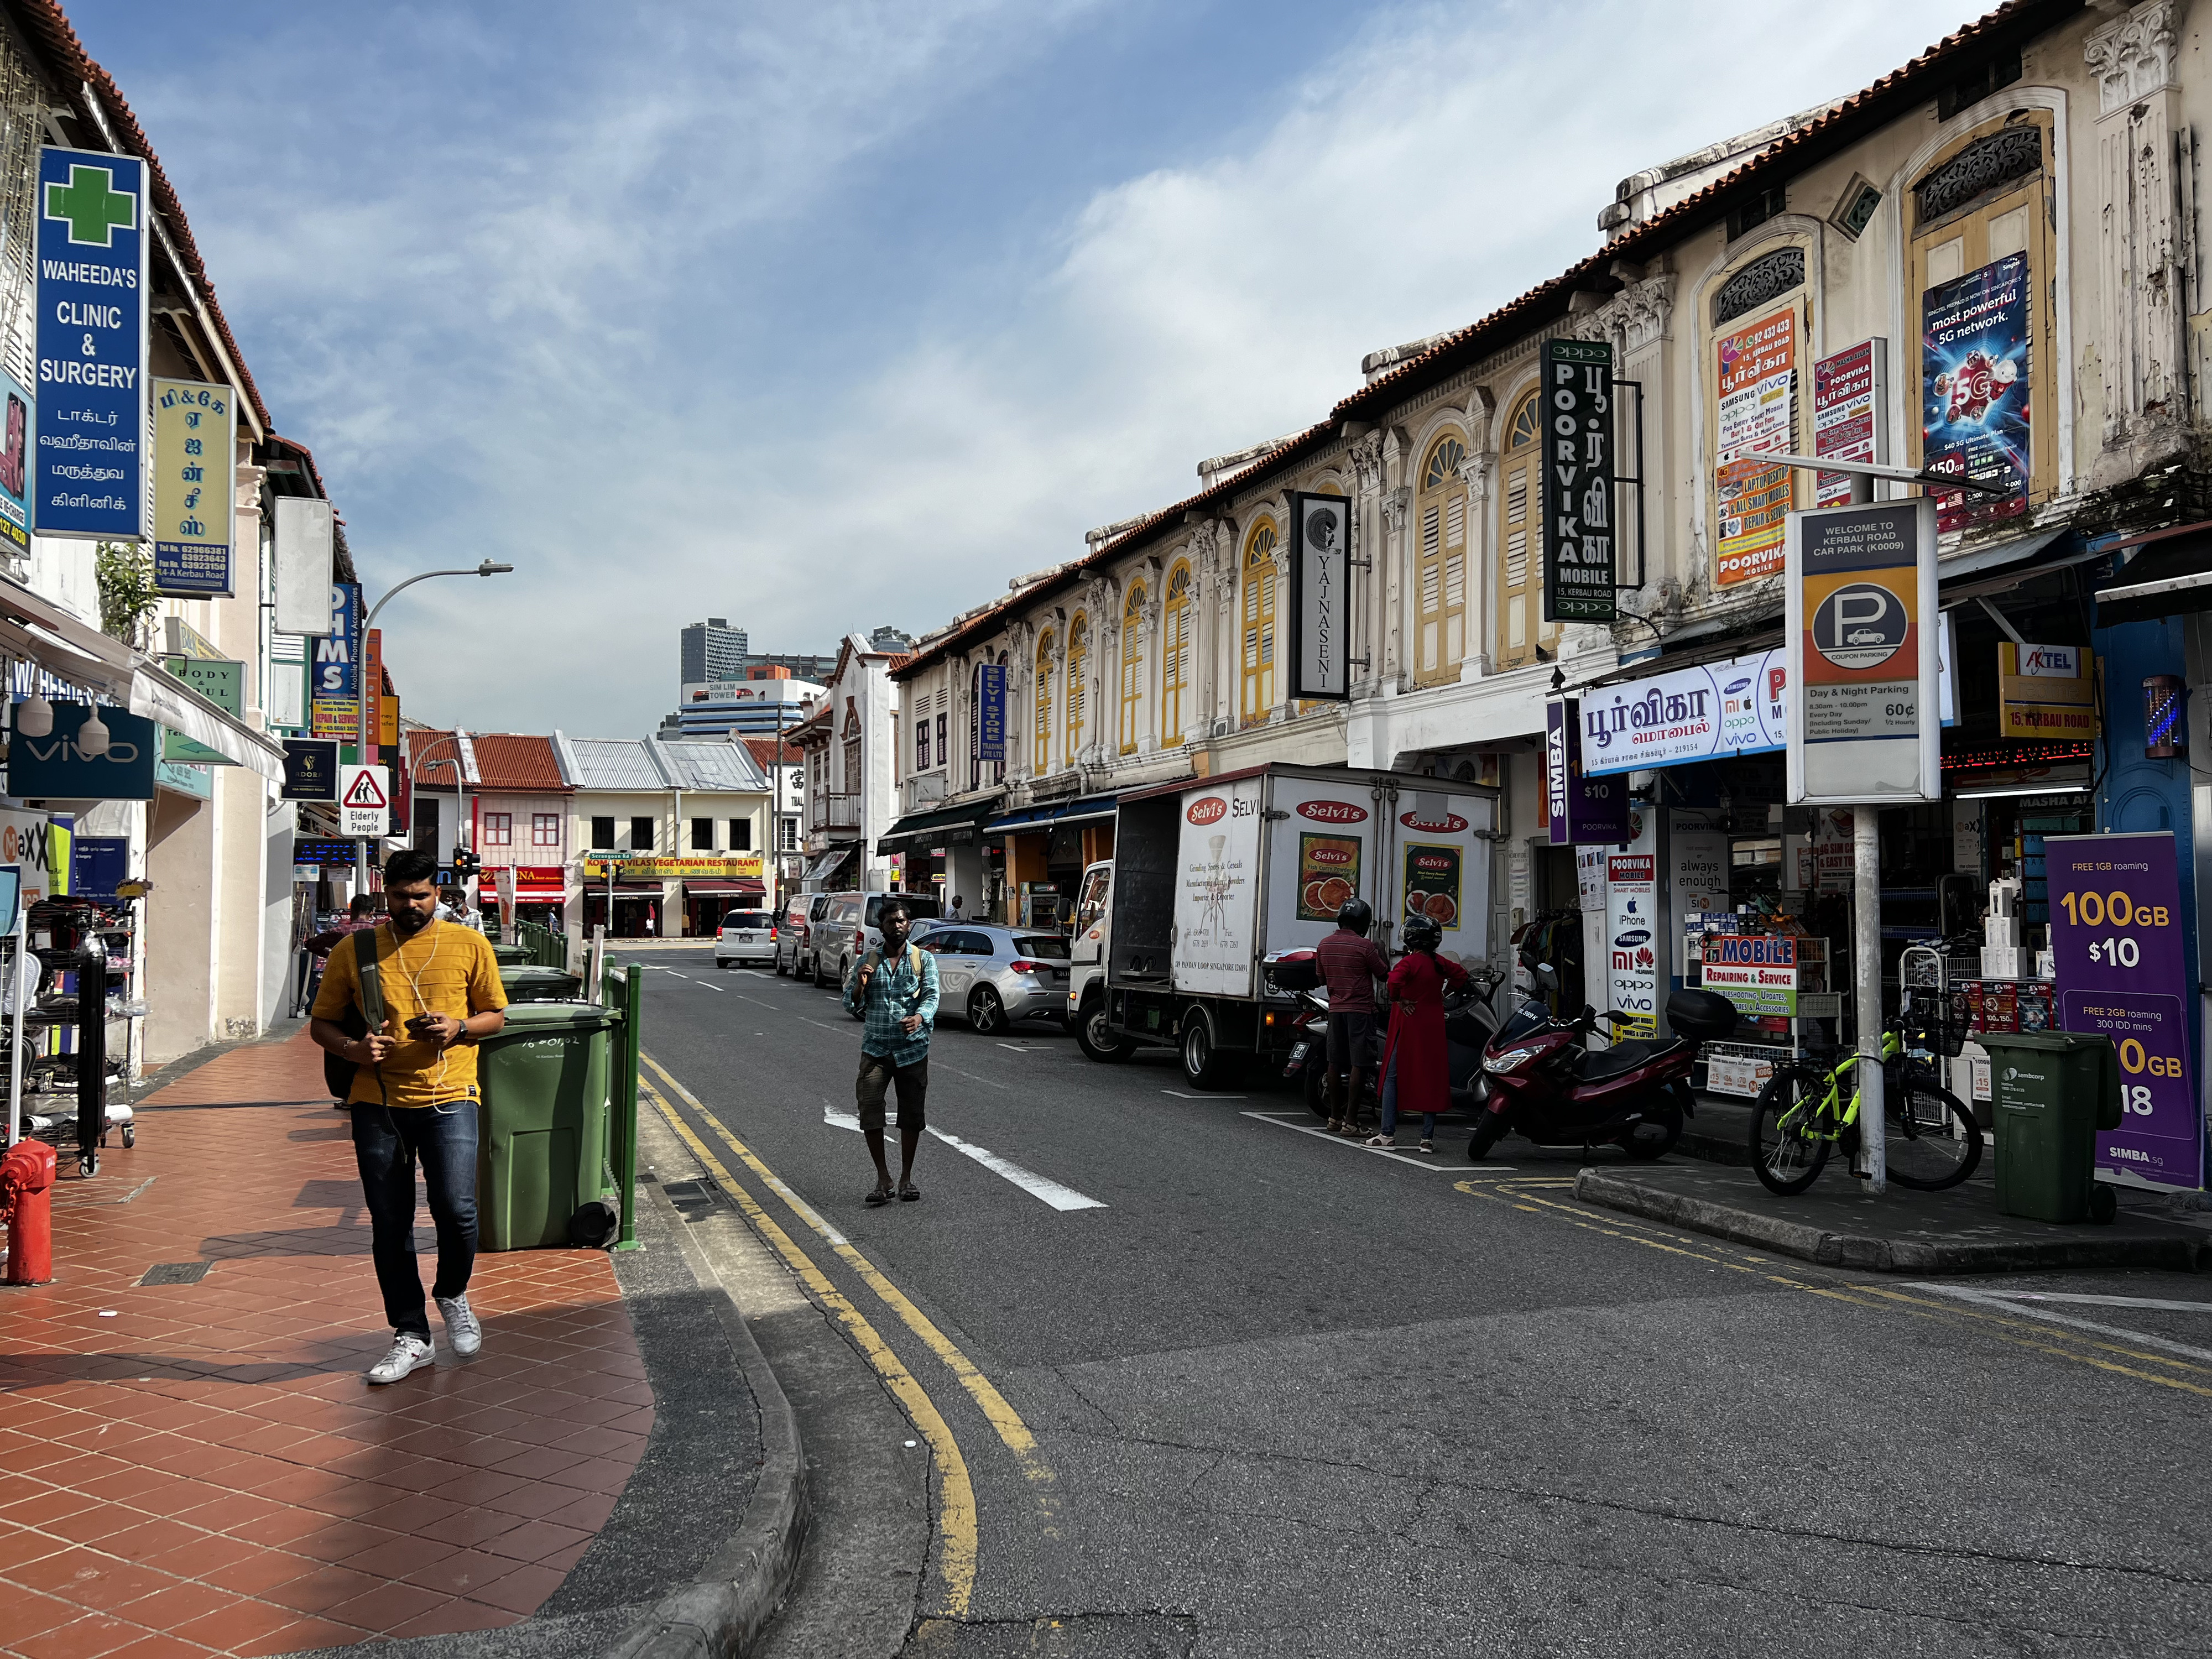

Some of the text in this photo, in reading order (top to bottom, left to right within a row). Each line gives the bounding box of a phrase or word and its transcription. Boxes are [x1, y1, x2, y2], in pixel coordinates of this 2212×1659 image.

[2003, 260, 2020, 270] Singtel
[42, 259, 137, 289] WAHEEDA'S
[56, 301, 121, 328] CLINIC
[1933, 289, 2016, 331] most powerful
[1755, 319, 1790, 345] 92 433 433
[1939, 311, 2008, 345] 5G network.
[81, 333, 96, 356] &
[1553, 346, 1607, 359] oppo
[1837, 347, 1869, 367] MASHA ALLAH
[40, 359, 136, 389] SURGERY
[1722, 351, 1787, 393] பூர்விகா
[1830, 364, 1870, 386] POORVIKA
[1757, 375, 1788, 395] vivo
[1721, 390, 1755, 410] SAMSUNG
[1846, 395, 1870, 408] vivo
[58, 409, 118, 427] டாக்டர்
[1720, 404, 1755, 421] oppo
[1817, 405, 1845, 421] SAMSUNG
[1818, 415, 1845, 429] oppo
[39, 434, 136, 452] வஹீதாவின்
[1965, 434, 1989, 444] Ultimate
[52, 463, 124, 481] மருத்துவ
[1554, 364, 1579, 564] POORVIKA
[51, 492, 126, 510] கிளினிக்
[1736, 499, 1746, 514] ALL
[1748, 493, 1768, 510] SMART
[1768, 483, 1790, 503] MOBILES
[1819, 491, 1833, 499] Singtel
[1825, 523, 1876, 535] WELCOME
[1823, 532, 1896, 545] KERBAU ROAD
[182, 546, 226, 555] 62966381
[1814, 541, 1903, 556] CAR PARK (K0009)
[181, 561, 226, 570] 63923150
[182, 554, 226, 562] 63923643
[177, 570, 204, 578] Kerbau
[206, 571, 225, 579] Road
[1560, 568, 1608, 585] MOBILE
[1557, 588, 1611, 598] 15, KERBAU ROAD
[1558, 601, 1611, 614] oppo
[1318, 555, 1331, 688] YAJNASENI
[1834, 592, 1887, 646] P
[179, 670, 229, 679] BODY
[986, 667, 1000, 702] SELVI
[1727, 682, 1748, 691] SAMSUNG
[1810, 690, 1829, 698] Day
[1841, 687, 1867, 696] Night
[1870, 686, 1909, 694] Parking
[1587, 688, 1709, 748] பூர்விகா
[1885, 703, 1914, 718] 60¢
[985, 706, 1000, 740] STORE
[1725, 717, 1755, 729] oppo
[2010, 712, 2089, 728] 15, KERBAU ROAD
[1632, 718, 1709, 744] மொபைல்
[1725, 733, 1756, 745] vivo
[1550, 726, 1564, 817] SIMBA
[1585, 785, 1609, 799] $10
[1191, 798, 1259, 821] Selvi's SELVI
[2019, 796, 2068, 807] MASHA
[351, 811, 379, 822] Elderly
[1306, 804, 1360, 820] Selvi's
[352, 823, 378, 833] People
[1314, 851, 1347, 860] Selvi's
[1830, 843, 1843, 853] SIM
[1418, 859, 1448, 867] Selvi's
[1611, 858, 1651, 870] POORVIKA
[1681, 860, 1719, 874] always
[2072, 863, 2094, 871] FREE
[2114, 862, 2148, 872] roaming
[1679, 875, 1720, 889] enough
[2060, 891, 2169, 926] 100GB
[1619, 915, 1645, 925] iPhone
[1722, 940, 1792, 964] MOBILE
[2089, 937, 2140, 967] $10
[1707, 968, 1791, 984] REPAIRING & SERVICE
[1614, 979, 1653, 990] oppo
[1616, 994, 1651, 1010] vivo
[1761, 990, 1787, 1002] UPDATES,
[2083, 1006, 2105, 1015] FREE
[2127, 1010, 2162, 1021] roaming
[2116, 1021, 2130, 1030] IDD
[2133, 1023, 2152, 1031] mins
[2111, 1038, 2182, 1077] 0GB
[2121, 1084, 2153, 1115] 18
